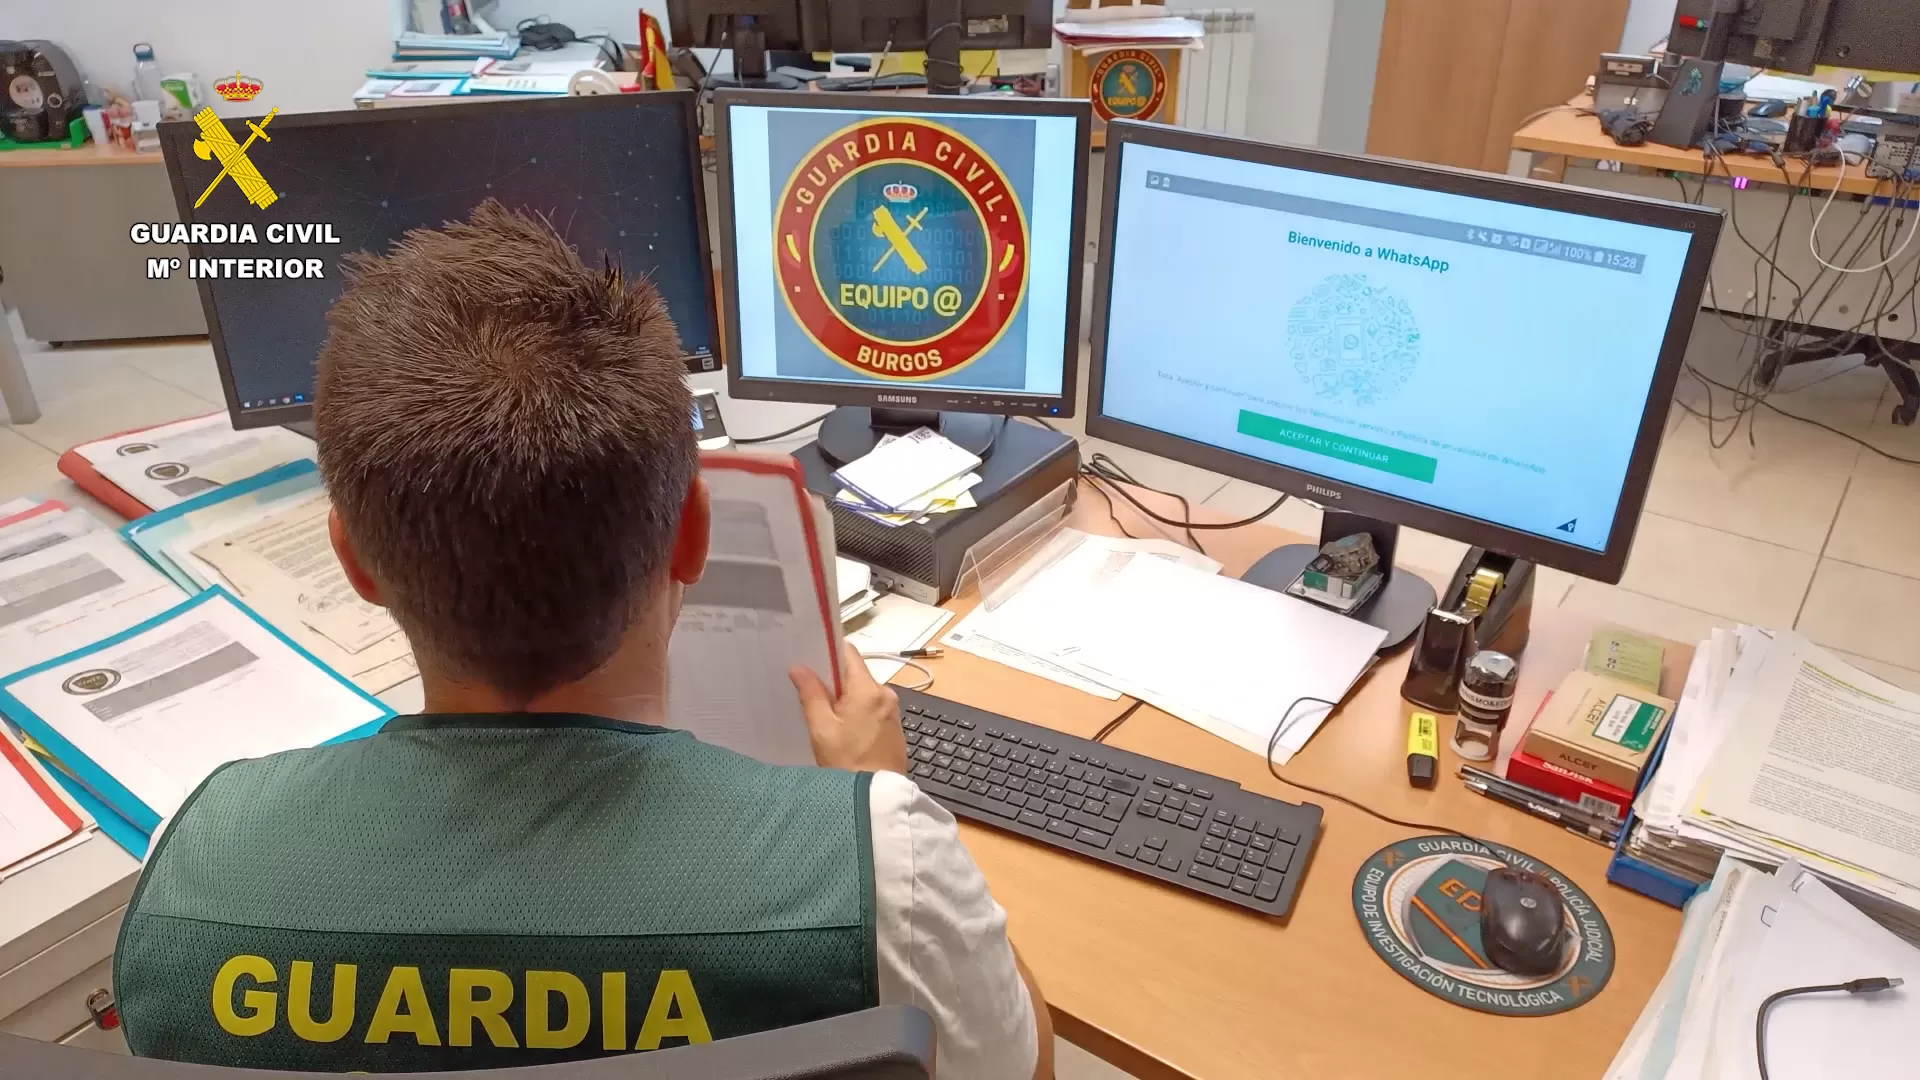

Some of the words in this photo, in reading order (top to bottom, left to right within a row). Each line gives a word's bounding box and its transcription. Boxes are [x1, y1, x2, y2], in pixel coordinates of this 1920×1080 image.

[796, 131, 916, 205] GUARDIA
[935, 141, 1003, 213] CIVIL
[1288, 231, 1361, 255] Bienvenido
[1364, 247, 1373, 257] a
[1377, 246, 1450, 274] WhatsApp
[1564, 246, 1592, 261] 100%
[1607, 253, 1638, 269] 15:28
[839, 283, 929, 310] EQUIPO
[932, 285, 963, 317] @
[856, 345, 943, 372] BURGOS
[877, 394, 918, 404] SAMSUNG
[1279, 428, 1322, 445] ACEPTAR
[1325, 439, 1331, 448] Y
[1333, 442, 1389, 463] CONTINUAR
[1306, 484, 1342, 500] PHILIPS
[1558, 753, 1598, 771] ALCEY
[1362, 868, 1385, 903] EQUIPO
[1417, 840, 1491, 855] GUARDIA
[1581, 917, 1604, 963] JUDICIAL
[1362, 903, 1380, 919] DE
[1367, 920, 1454, 993] INVESTIGACIÓN
[212, 954, 714, 1050] GUARDIA
[1457, 984, 1565, 1008] TECNOLÓGICA
